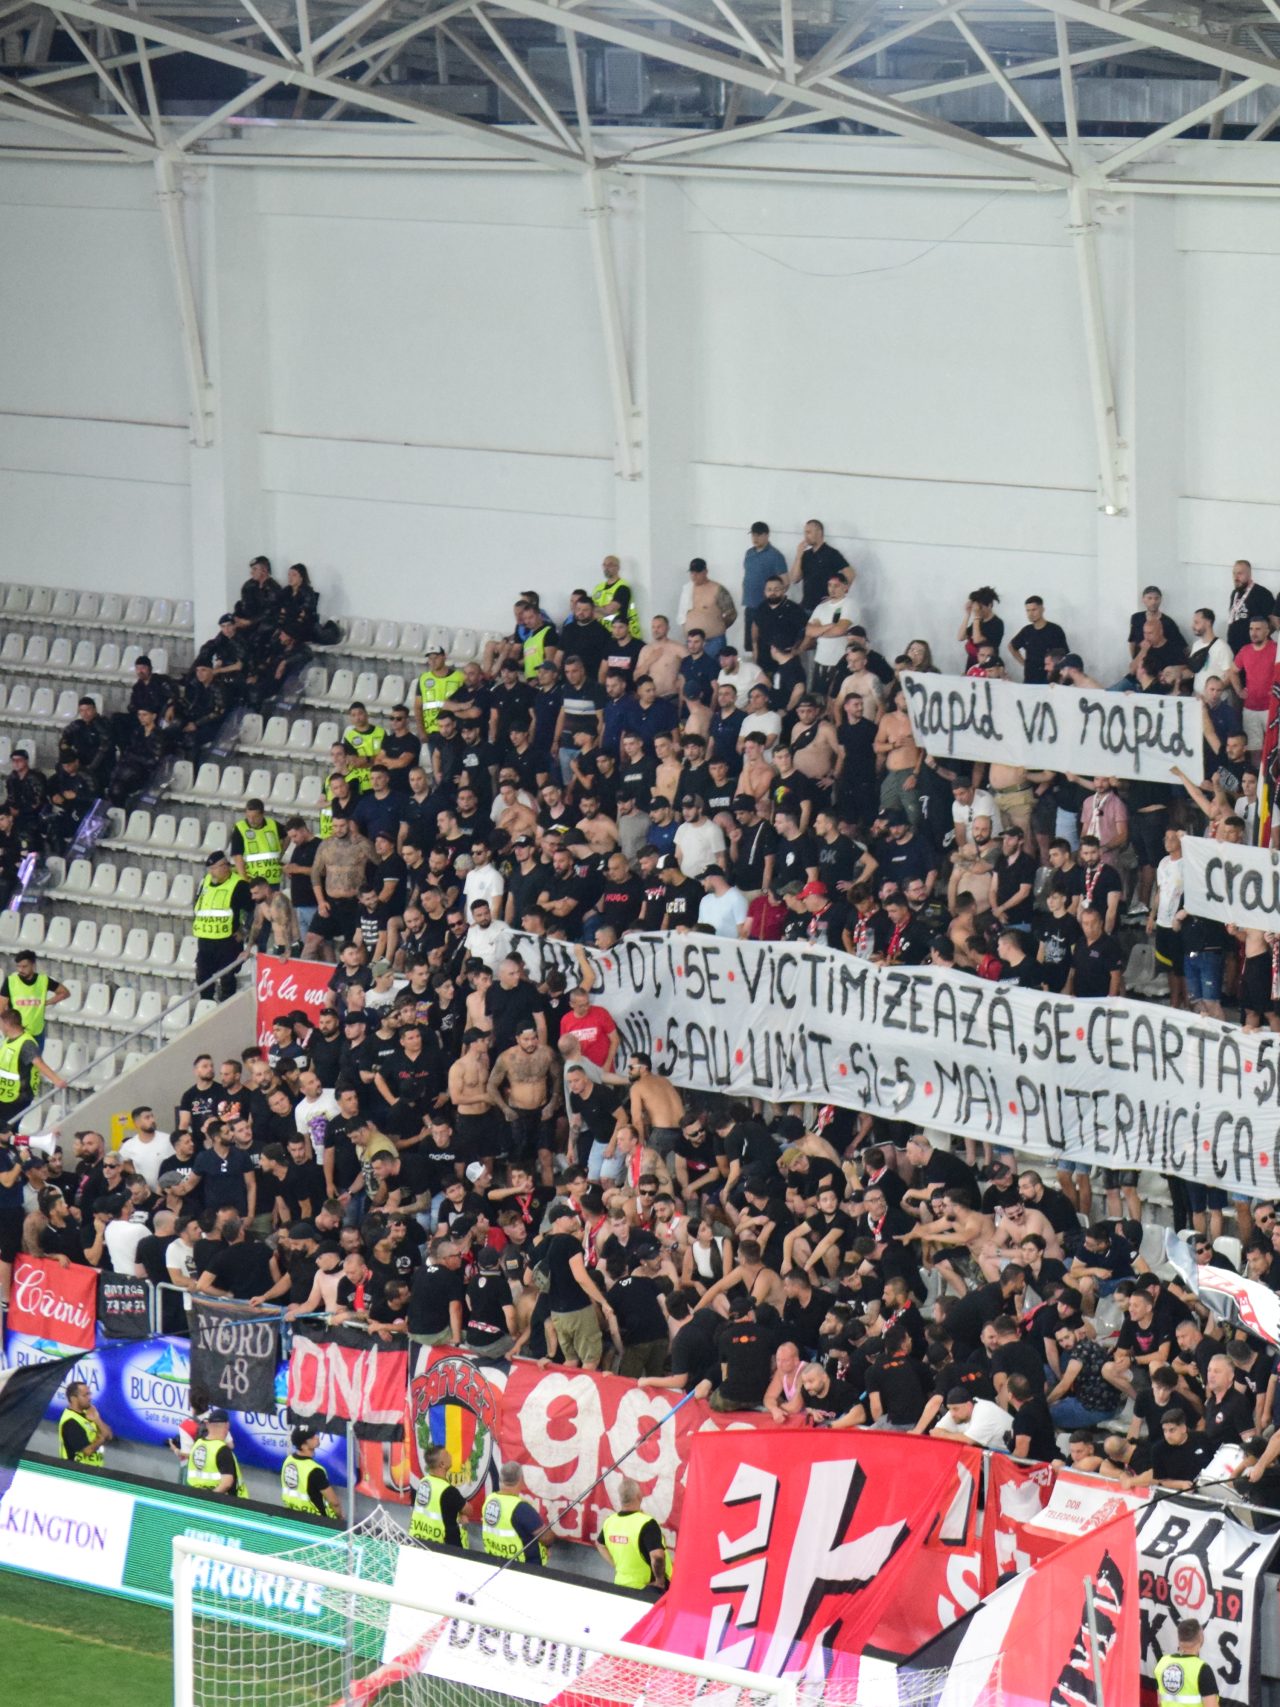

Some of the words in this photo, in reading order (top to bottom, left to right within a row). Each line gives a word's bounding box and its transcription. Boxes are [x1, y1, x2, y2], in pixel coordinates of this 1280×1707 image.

[905, 676, 1003, 754] rapid
[1017, 699, 1058, 744] vs
[1079, 696, 1194, 774] rapid
[277, 974, 298, 1002] la
[304, 988, 328, 1006] no
[684, 944, 726, 1004] SE
[1033, 1000, 1075, 1063] SE
[1212, 1110, 1258, 1186] CA
[197, 1313, 275, 1358] NORD
[219, 1358, 250, 1401] 48
[1141, 1572, 1168, 1601] 20
[1215, 1589, 1241, 1621] 19
